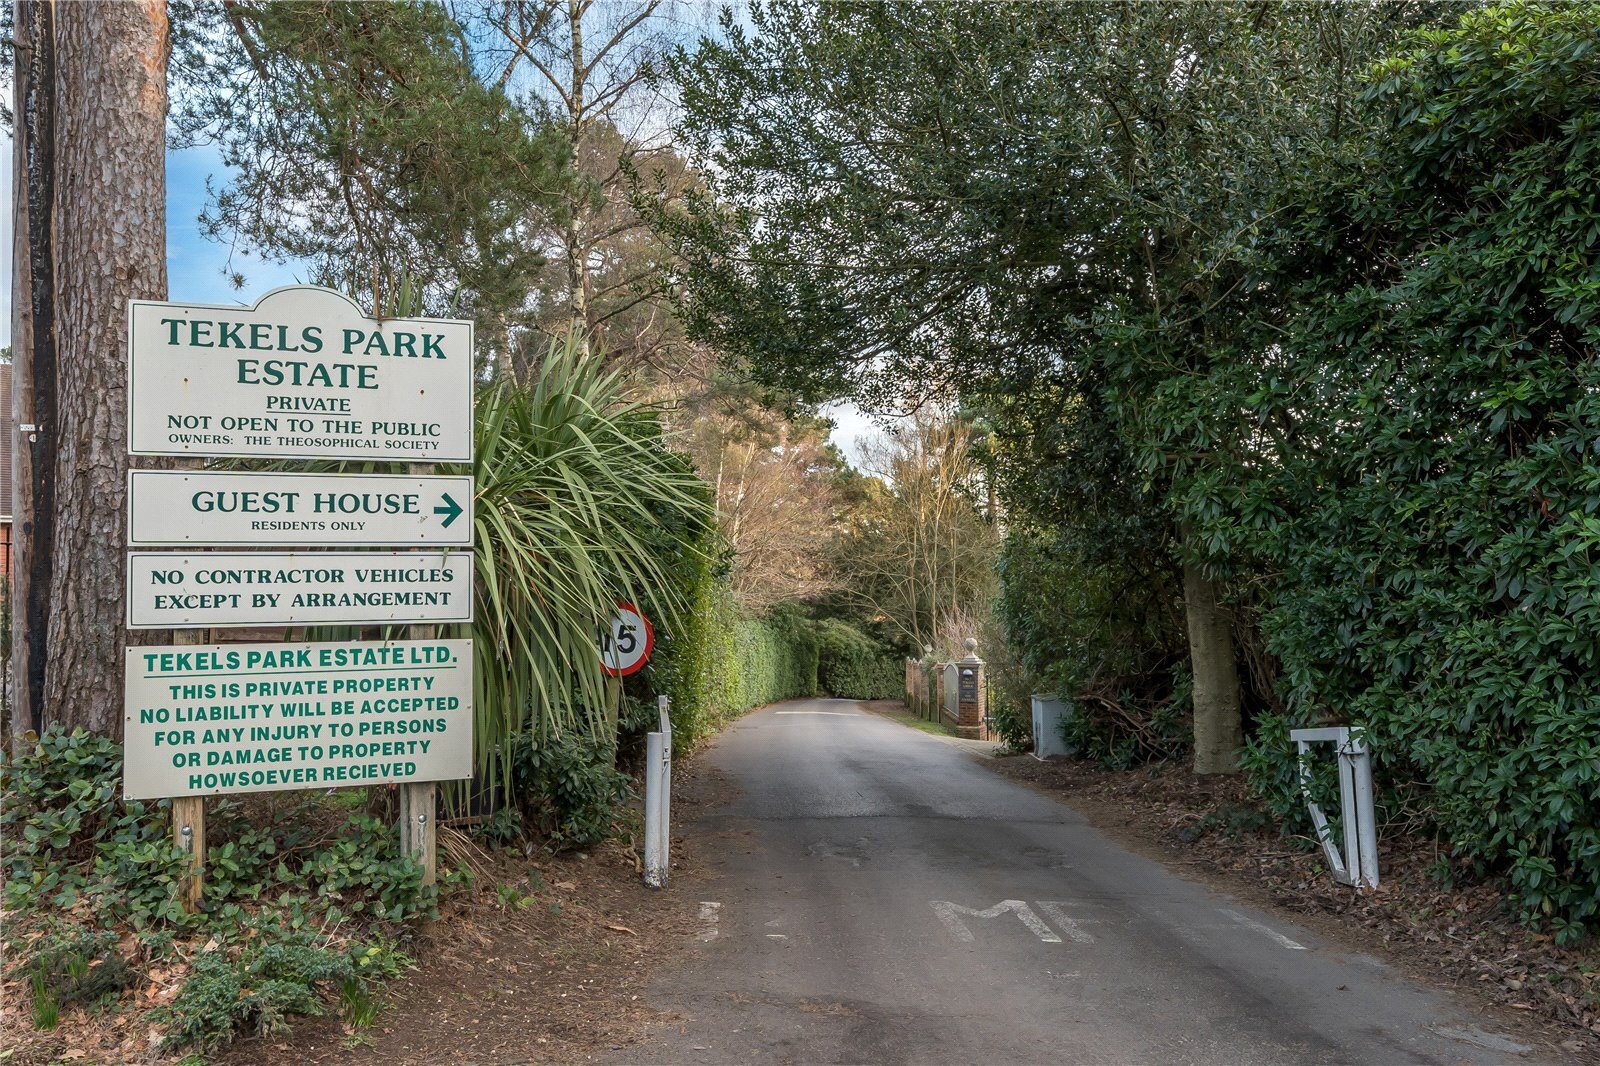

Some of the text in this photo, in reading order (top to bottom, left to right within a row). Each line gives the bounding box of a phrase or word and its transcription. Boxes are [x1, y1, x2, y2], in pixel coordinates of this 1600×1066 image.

[160, 318, 447, 360] TEKELS PARK
[236, 358, 379, 390] ESTATE
[266, 395, 351, 412] PRIVATE
[167, 414, 441, 437] NOT OPEN TO THE PUBLIC
[168, 434, 440, 450] OWNERS: THE THEOSOPHICAL SOCIETY
[191, 490, 421, 515] GUEST HOUSE
[251, 520, 366, 531] RESIDENTS ONLY
[150, 568, 454, 585] NO CONTRACTOR VEHICLES
[154, 591, 452, 610] EXCEPT BY ARRANGEMENT
[143, 646, 458, 672] TEKELS PARK ESTATE LTD.
[168, 676, 435, 701] THIS IS PRIVATE PROPERTY
[140, 696, 460, 724] NO LIABILITY WILL BE ACCEPTED
[154, 717, 447, 747] FOR ANY INJURY TO PERSONS
[172, 739, 431, 769] OR DAMAGE TO PROPERTY
[188, 761, 417, 790] HOWSOEVER RECIEVED
